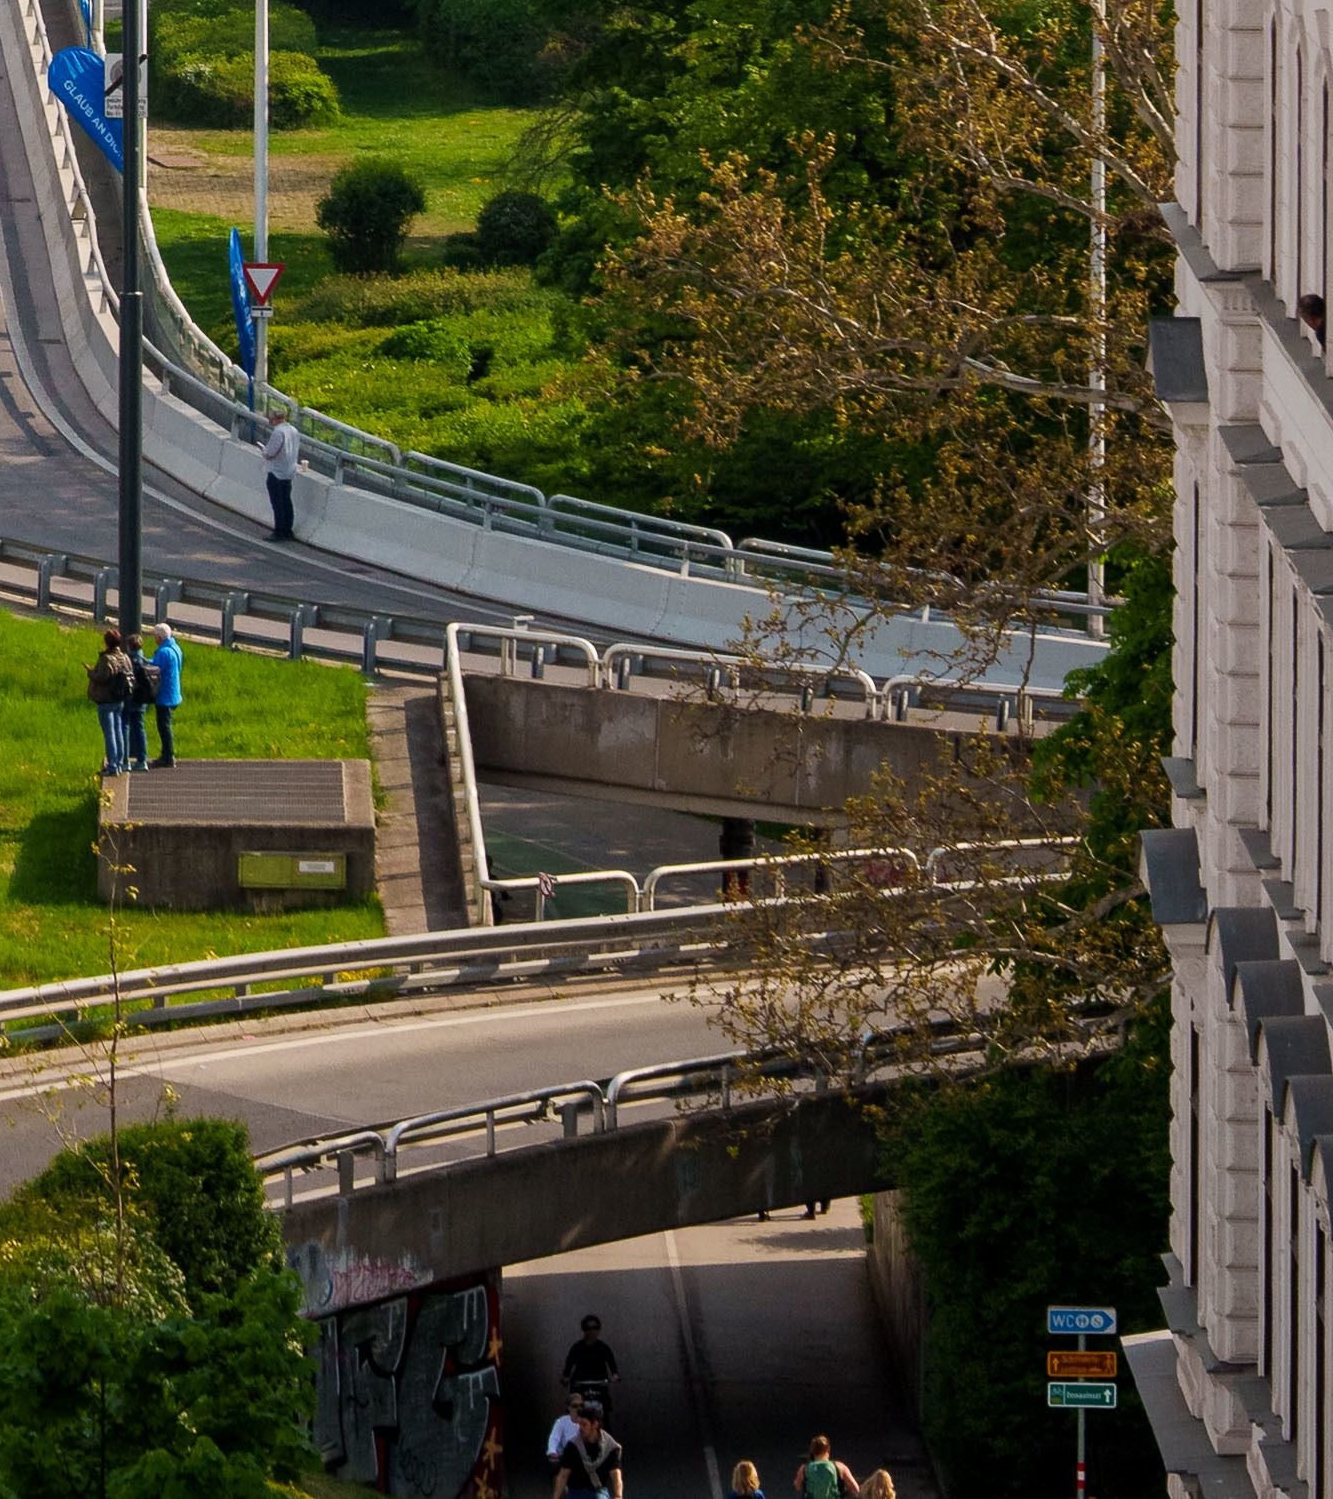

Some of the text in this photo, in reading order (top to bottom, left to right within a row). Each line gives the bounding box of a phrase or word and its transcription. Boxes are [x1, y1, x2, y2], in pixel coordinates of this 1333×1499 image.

[63, 80, 94, 118] GLAUB
[91, 117, 106, 135] AN
[1052, 1314, 1074, 1328] WC
